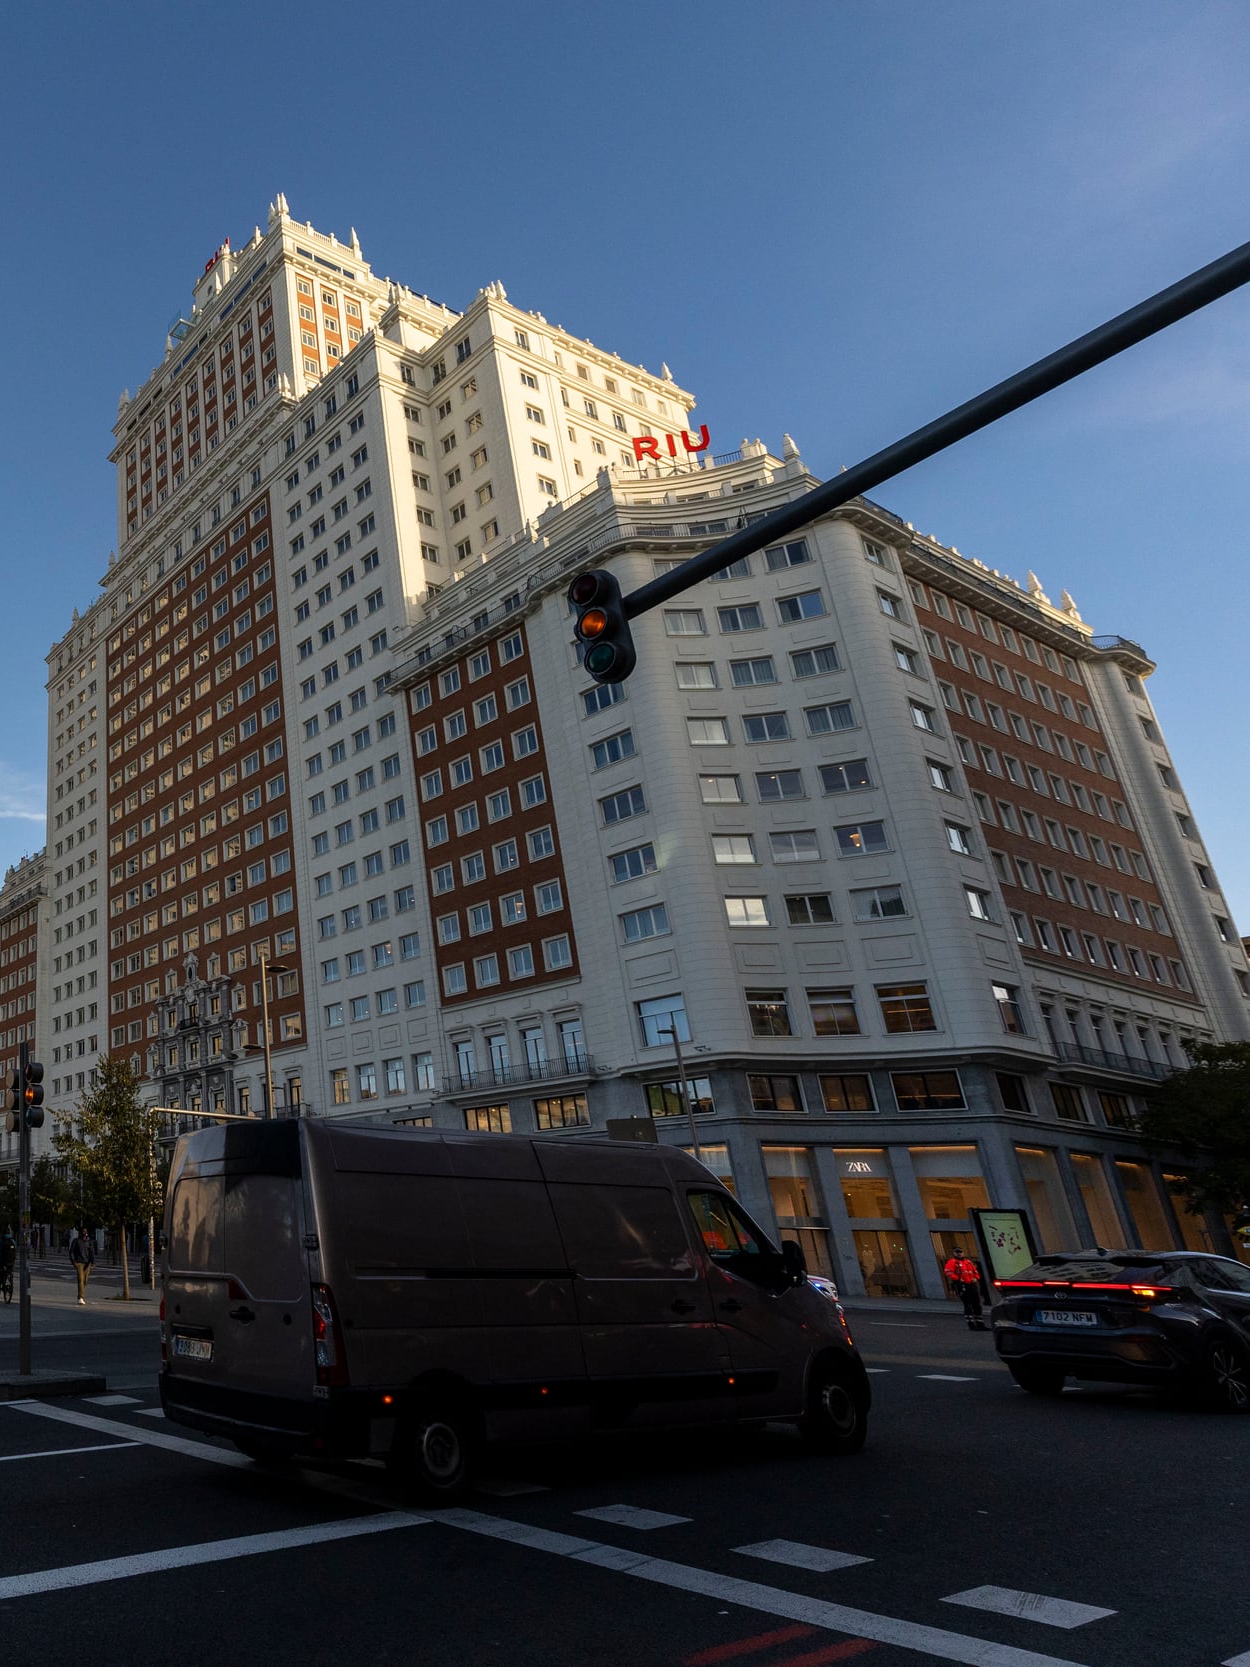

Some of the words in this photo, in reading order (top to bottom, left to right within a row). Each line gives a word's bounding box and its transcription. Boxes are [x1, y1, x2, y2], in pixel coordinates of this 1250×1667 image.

[632, 424, 710, 461] RIU
[845, 1161, 872, 1172] ZARA
[1043, 1311, 1070, 1321] 7102
